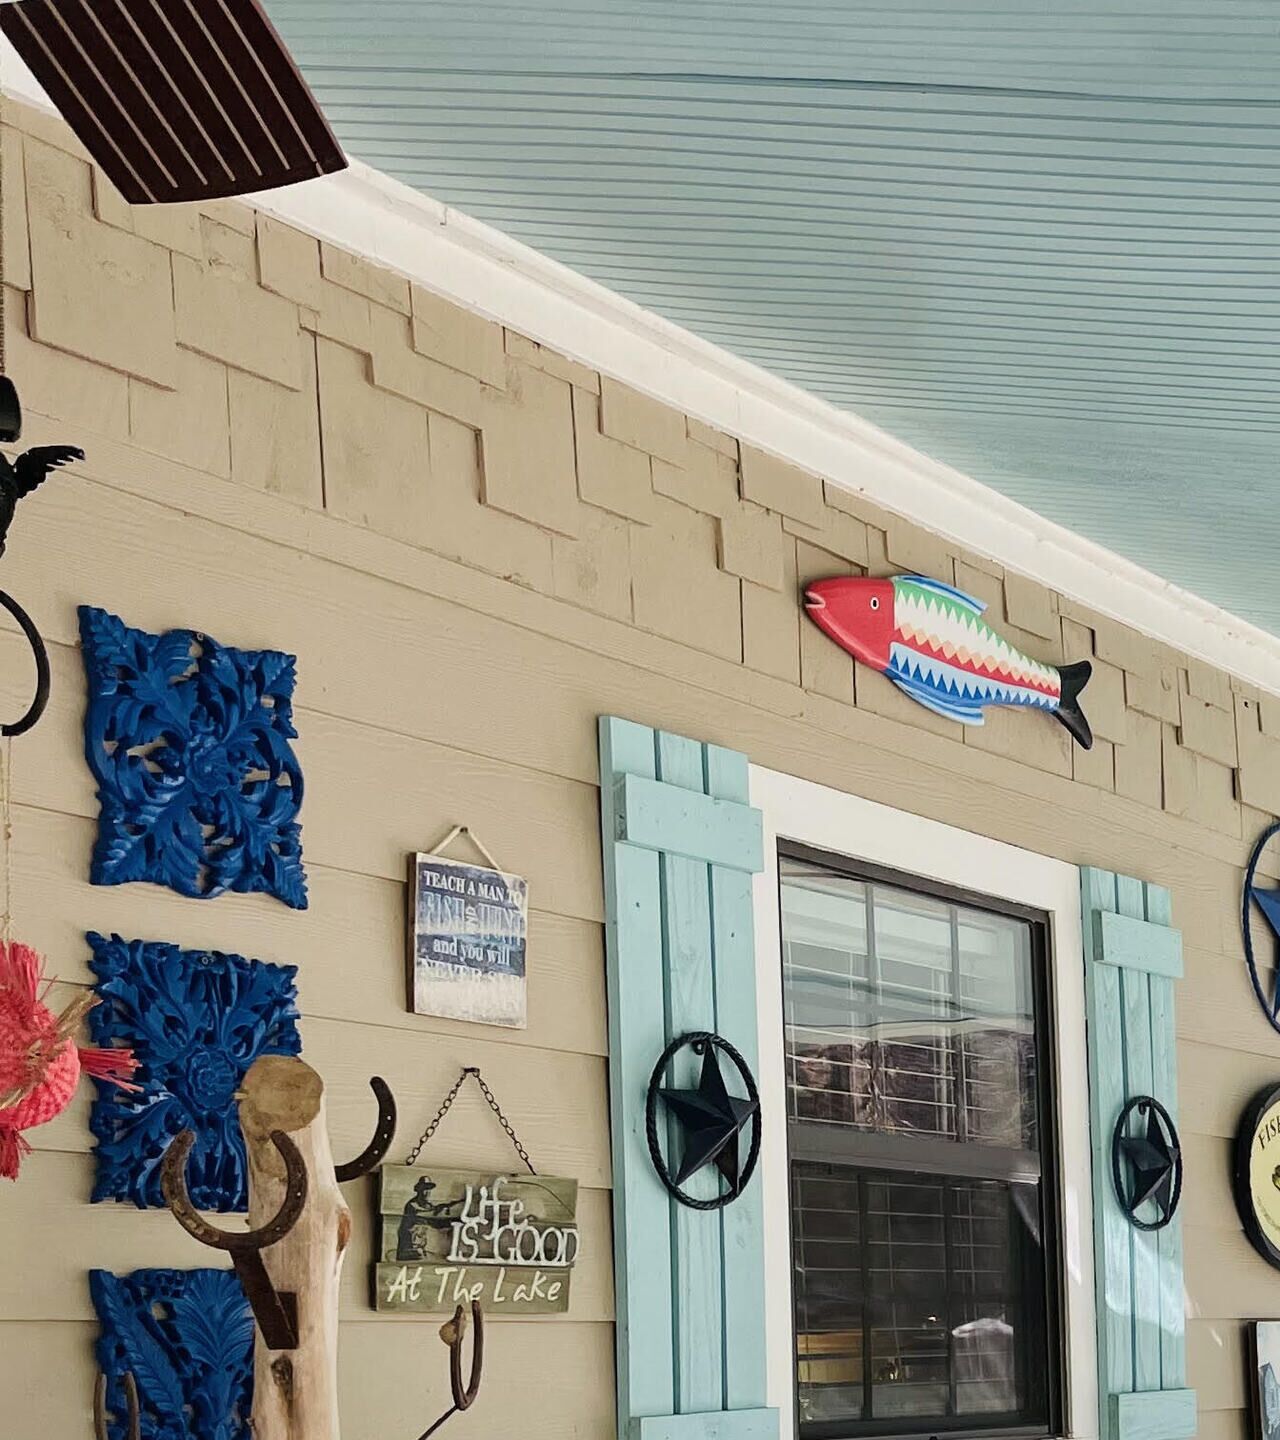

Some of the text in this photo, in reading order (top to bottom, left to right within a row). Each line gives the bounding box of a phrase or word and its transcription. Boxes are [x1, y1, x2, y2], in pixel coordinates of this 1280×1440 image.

[424, 871, 523, 908] TEACH A MAN TO
[422, 890, 466, 933] FISH
[433, 937, 510, 966] and you will
[460, 1176, 529, 1240] Life
[447, 1221, 580, 1266] IS GOOD
[387, 1266, 563, 1303] At The Lake
